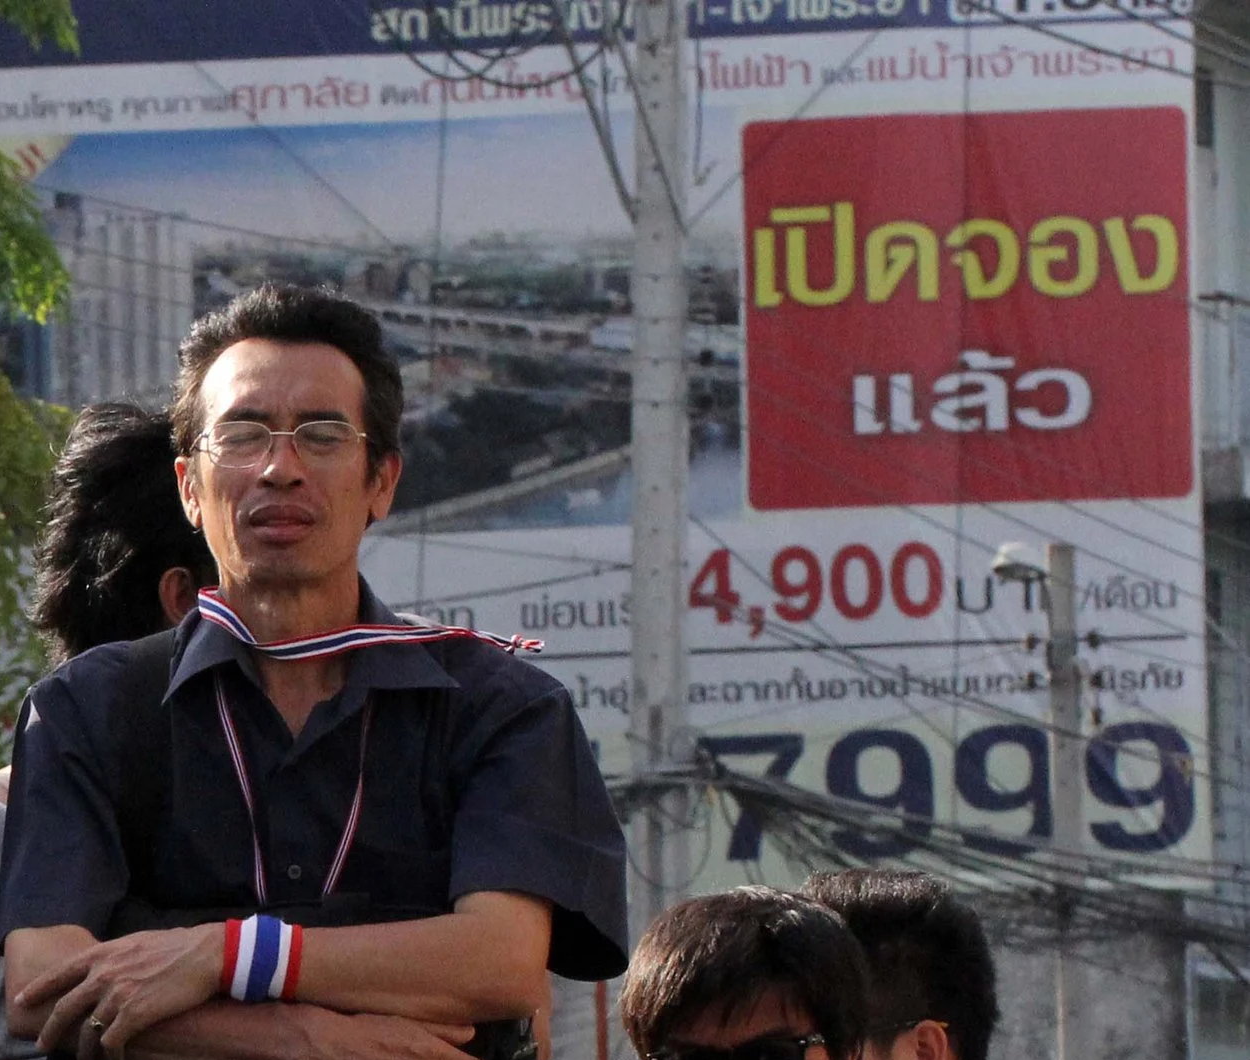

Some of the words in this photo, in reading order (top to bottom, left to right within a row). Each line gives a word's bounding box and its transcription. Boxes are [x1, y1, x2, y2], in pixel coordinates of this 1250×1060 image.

[753, 202, 1179, 309] เปิดจอง
[853, 349, 1093, 436] แล้ว
